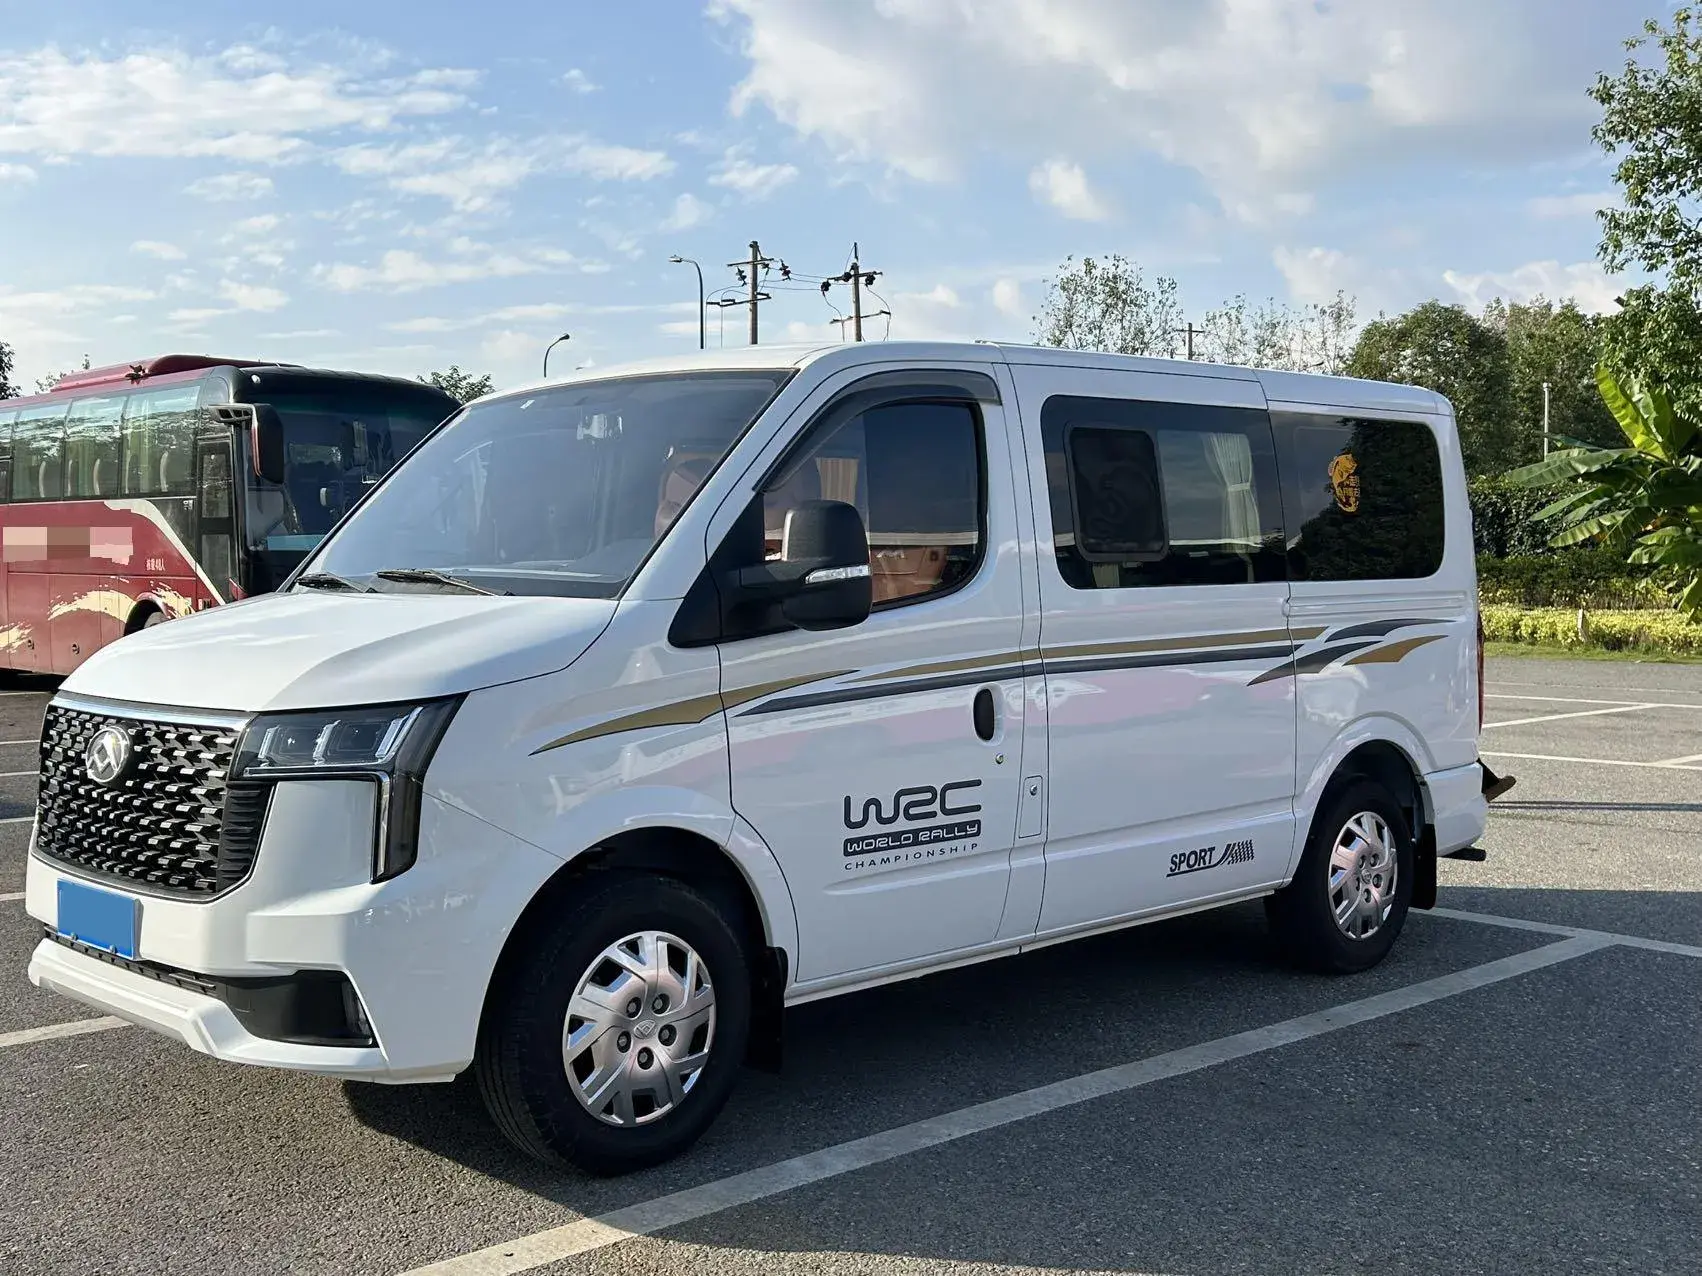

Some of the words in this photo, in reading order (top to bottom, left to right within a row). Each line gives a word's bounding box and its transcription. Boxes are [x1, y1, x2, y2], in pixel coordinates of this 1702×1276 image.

[844, 779, 982, 829] WRC
[847, 833, 913, 852] WORLD
[918, 823, 978, 842] RALLY
[844, 843, 978, 871] CHAMPIONSHIP
[1169, 846, 1216, 873] SPORT
